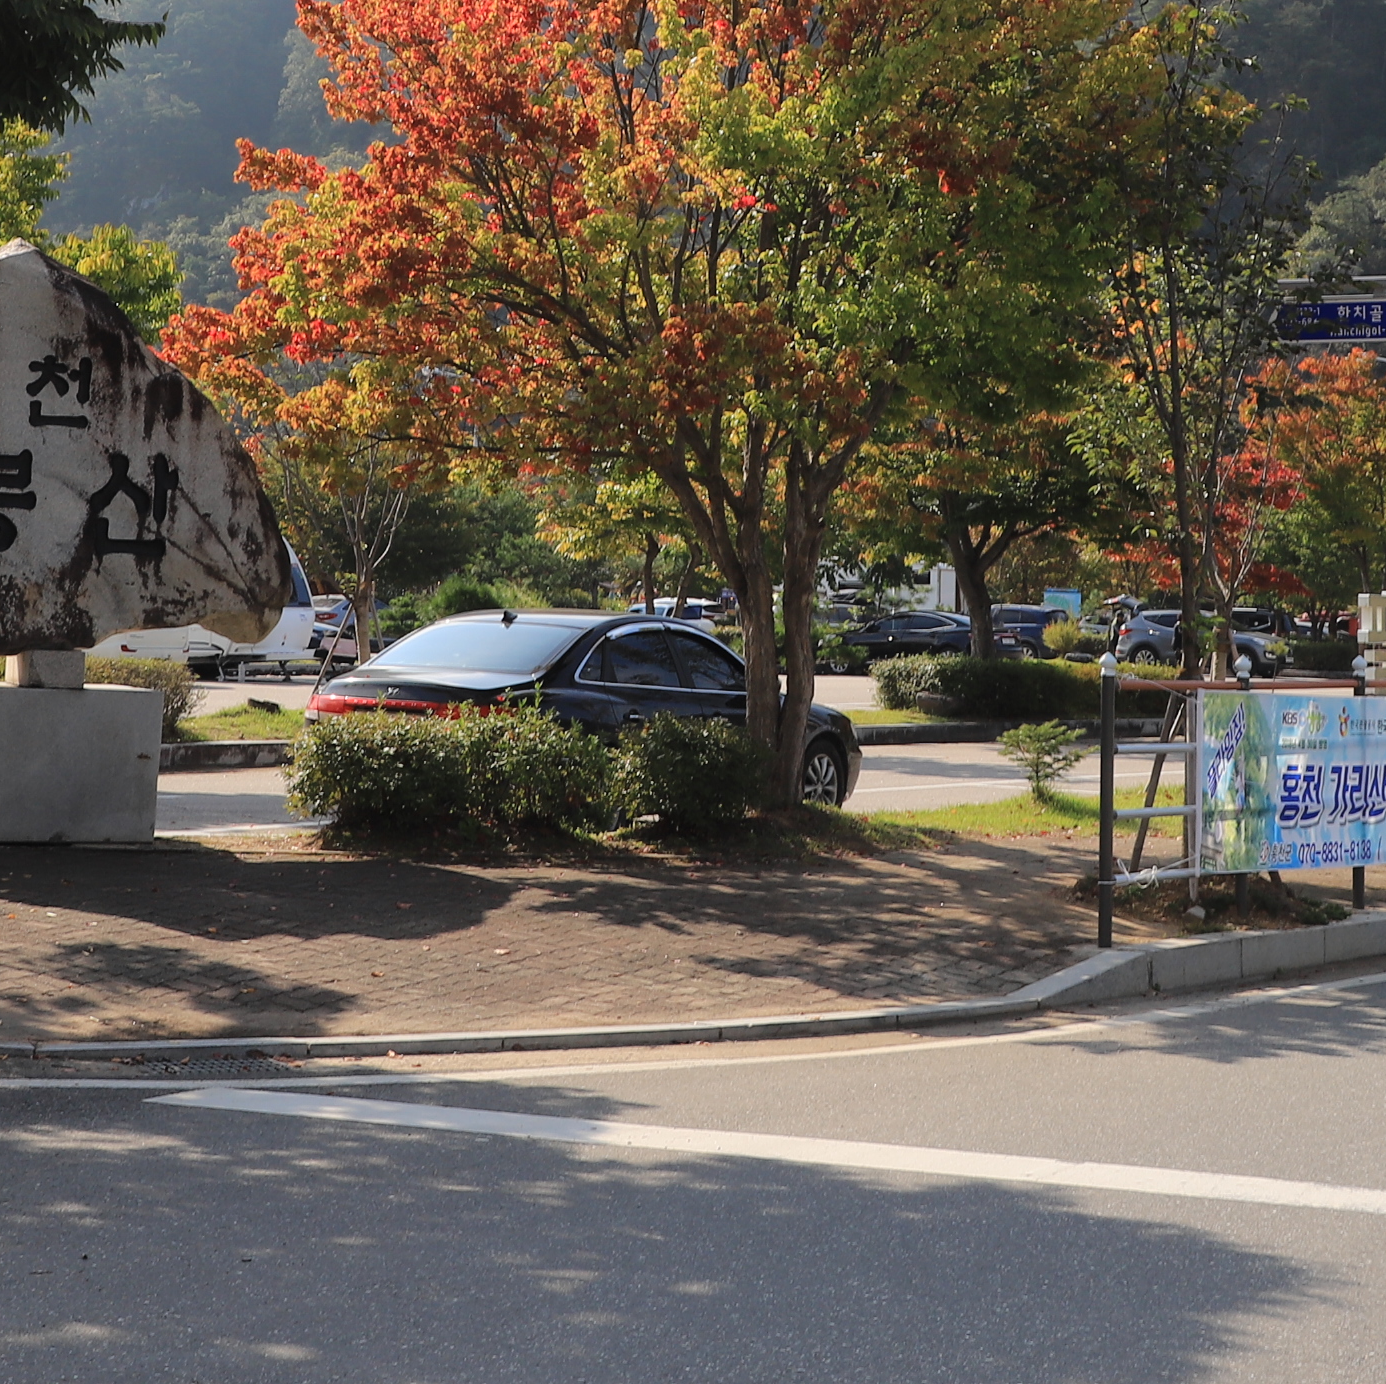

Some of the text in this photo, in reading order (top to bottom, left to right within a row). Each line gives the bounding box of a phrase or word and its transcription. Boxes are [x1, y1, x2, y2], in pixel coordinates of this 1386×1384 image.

[1282, 712, 1298, 724] KBS
[1279, 764, 1324, 821] 홍천
[1297, 839, 1372, 864] 070-8831-8138
